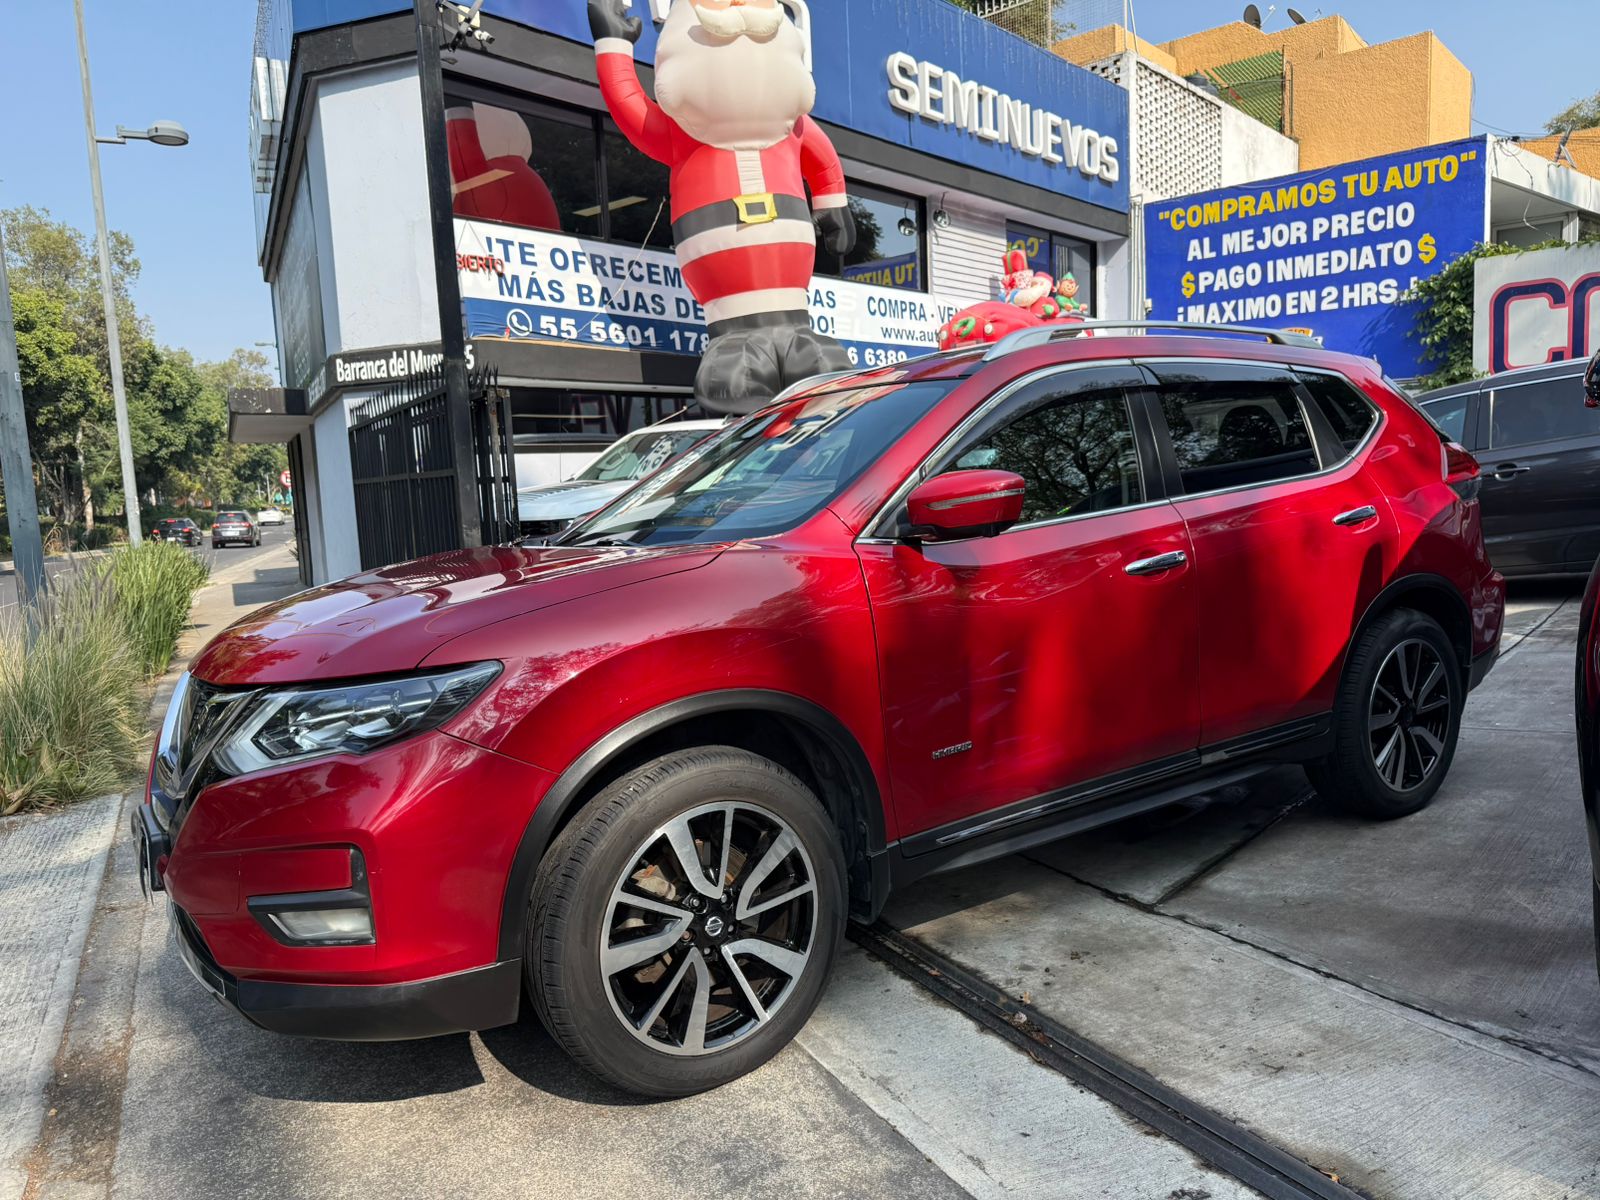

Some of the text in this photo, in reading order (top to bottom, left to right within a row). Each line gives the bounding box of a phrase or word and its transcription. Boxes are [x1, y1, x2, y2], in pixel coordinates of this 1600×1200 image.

[887, 51, 1119, 182] SEMINUEVOS
[1343, 171, 1378, 199] TU
[1187, 201, 1415, 262] AL MEJOR PRECIO
[550, 247, 682, 289] OFRECEM
[1267, 239, 1413, 283] INMEDIATO
[498, 271, 565, 303] MÁS
[577, 282, 666, 316] BAJAS
[675, 297, 705, 321] DE
[867, 295, 928, 322] COMPRA
[1286, 290, 1315, 315] EN
[1320, 286, 1339, 311] 2
[540, 315, 578, 341] 55
[590, 321, 657, 347] 5601
[335, 358, 387, 382] Barranca
[388, 350, 409, 377] del
